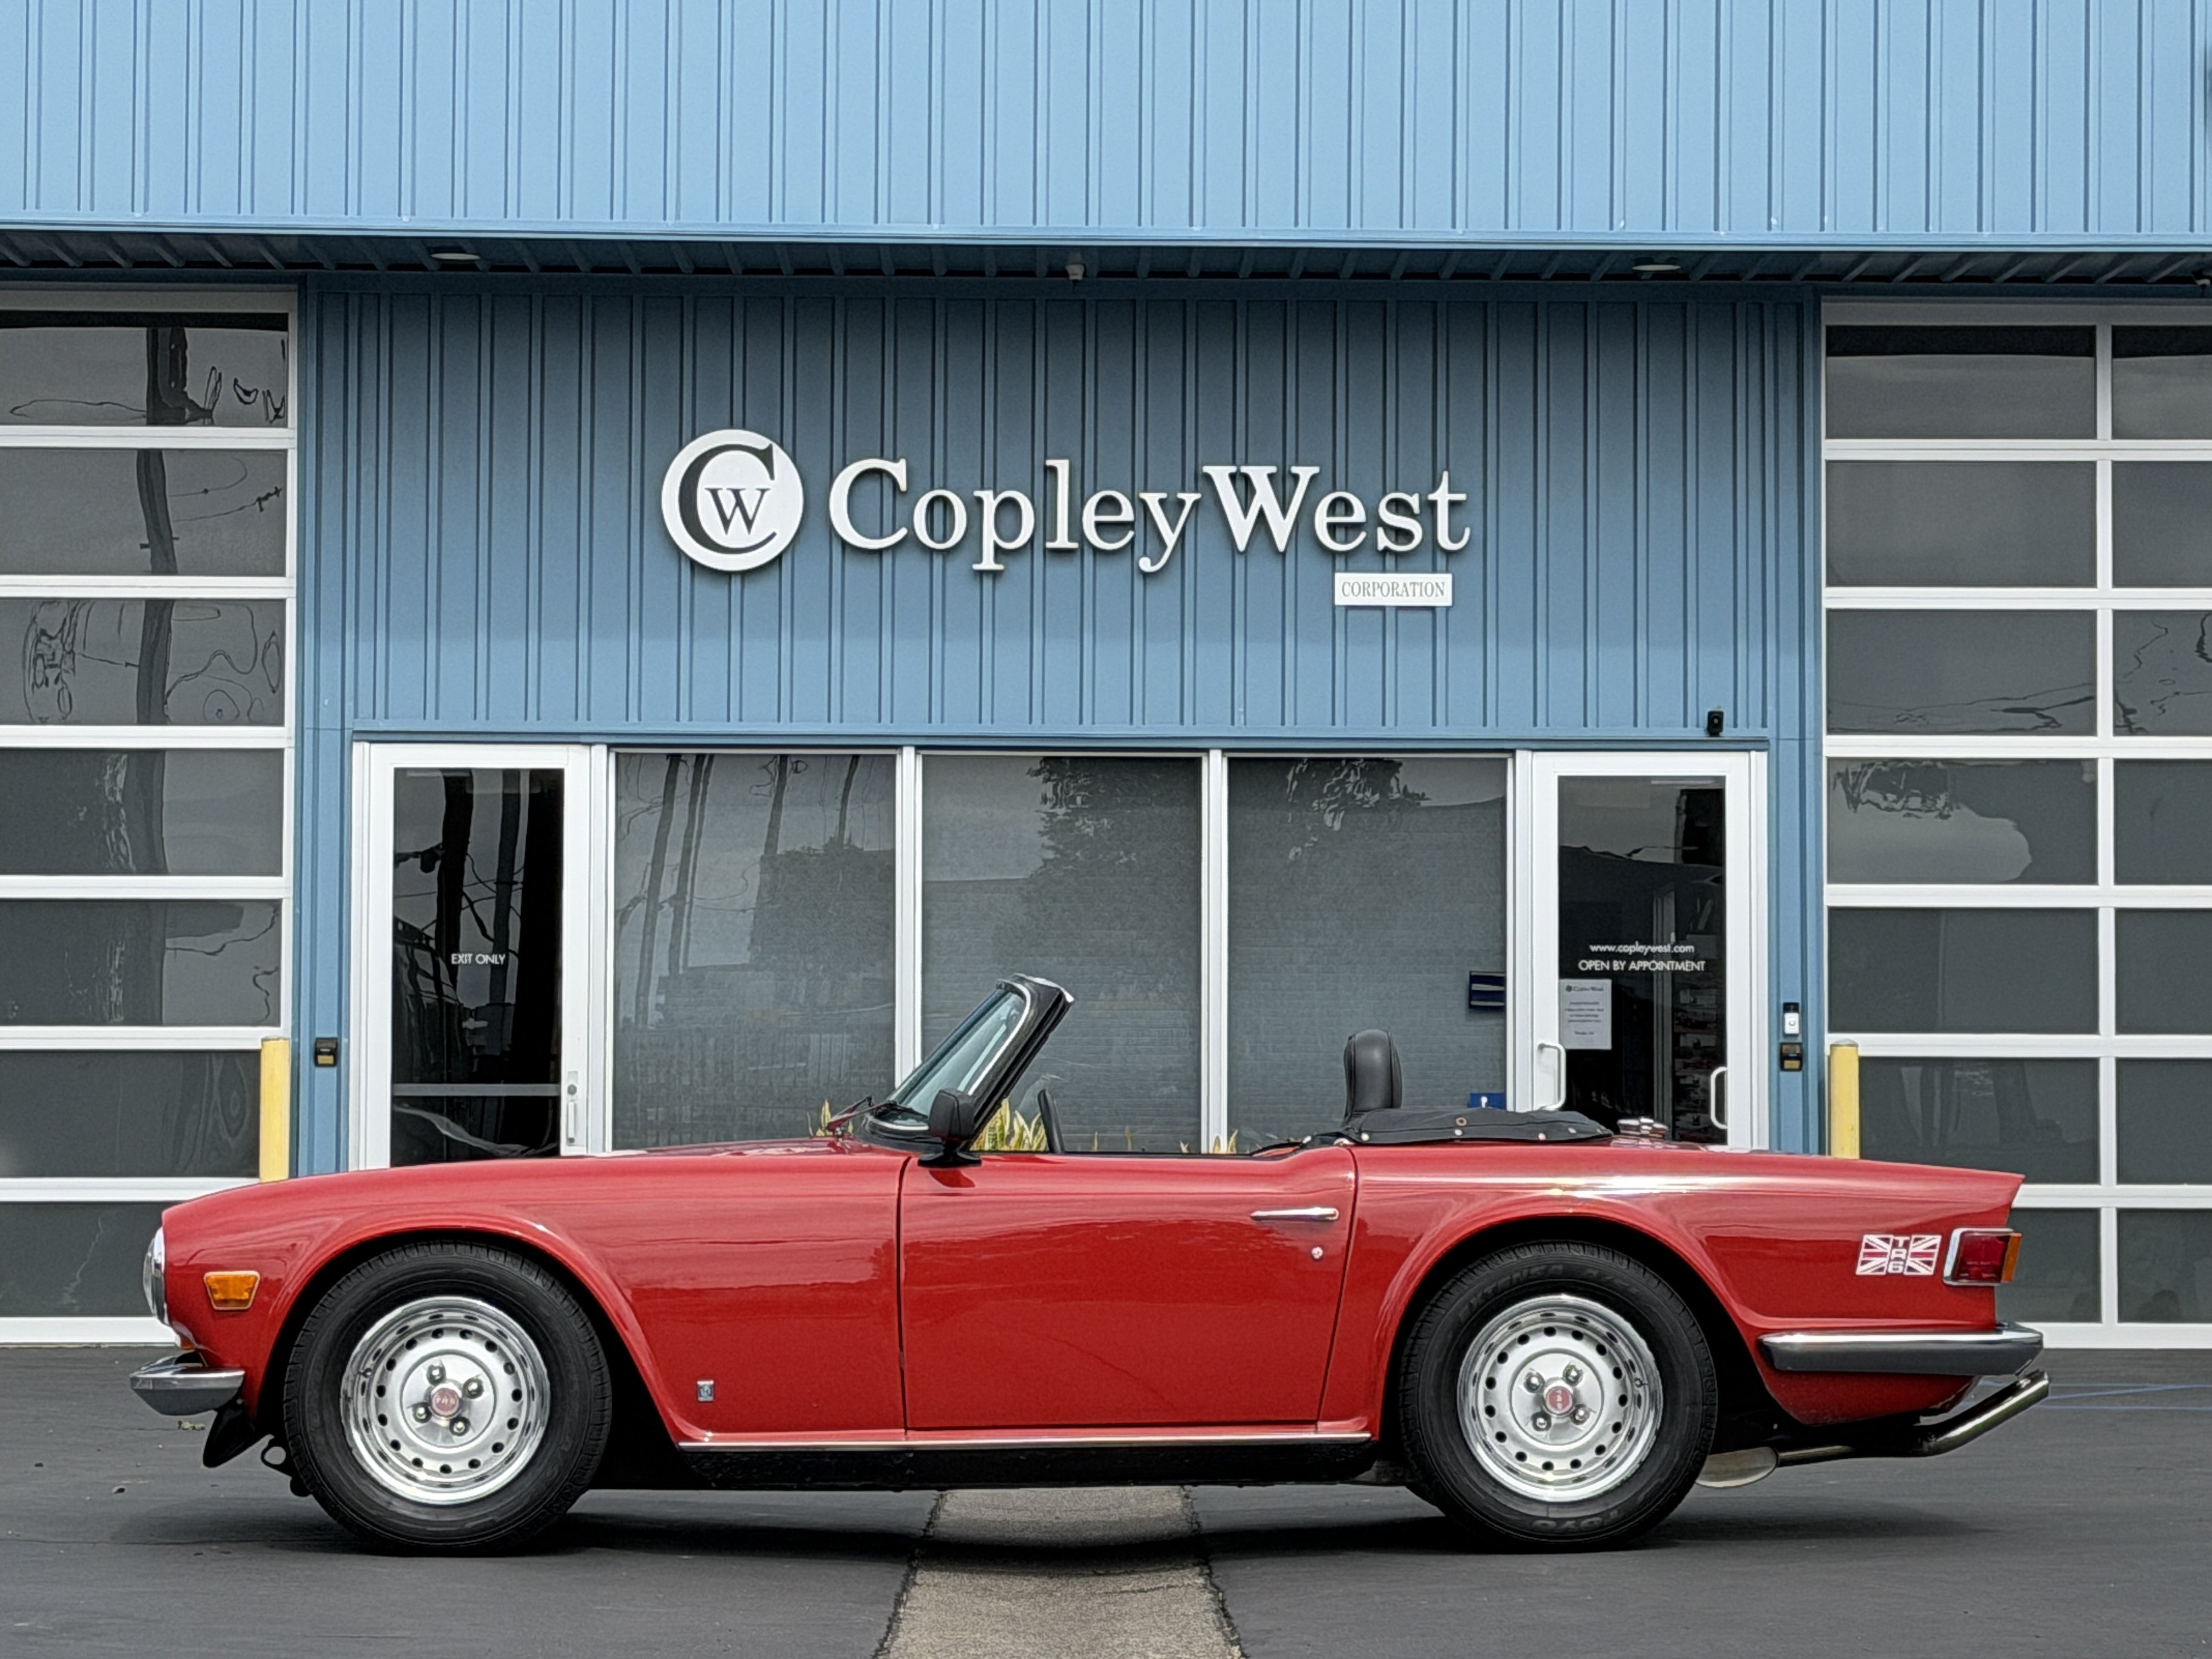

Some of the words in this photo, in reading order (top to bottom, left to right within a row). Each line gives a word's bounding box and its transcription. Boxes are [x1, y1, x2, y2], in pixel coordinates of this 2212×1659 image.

[1341, 581, 1446, 597] CORPORATION
[1589, 940, 1695, 956] www.copleywest.com
[451, 953, 473, 965] EXIT
[475, 953, 506, 966] ONLY
[1578, 960, 1610, 971] OPEN
[1613, 960, 1627, 971] BY
[1628, 960, 1706, 972] APPOINTMENT
[1887, 1235, 1910, 1273] TR6
